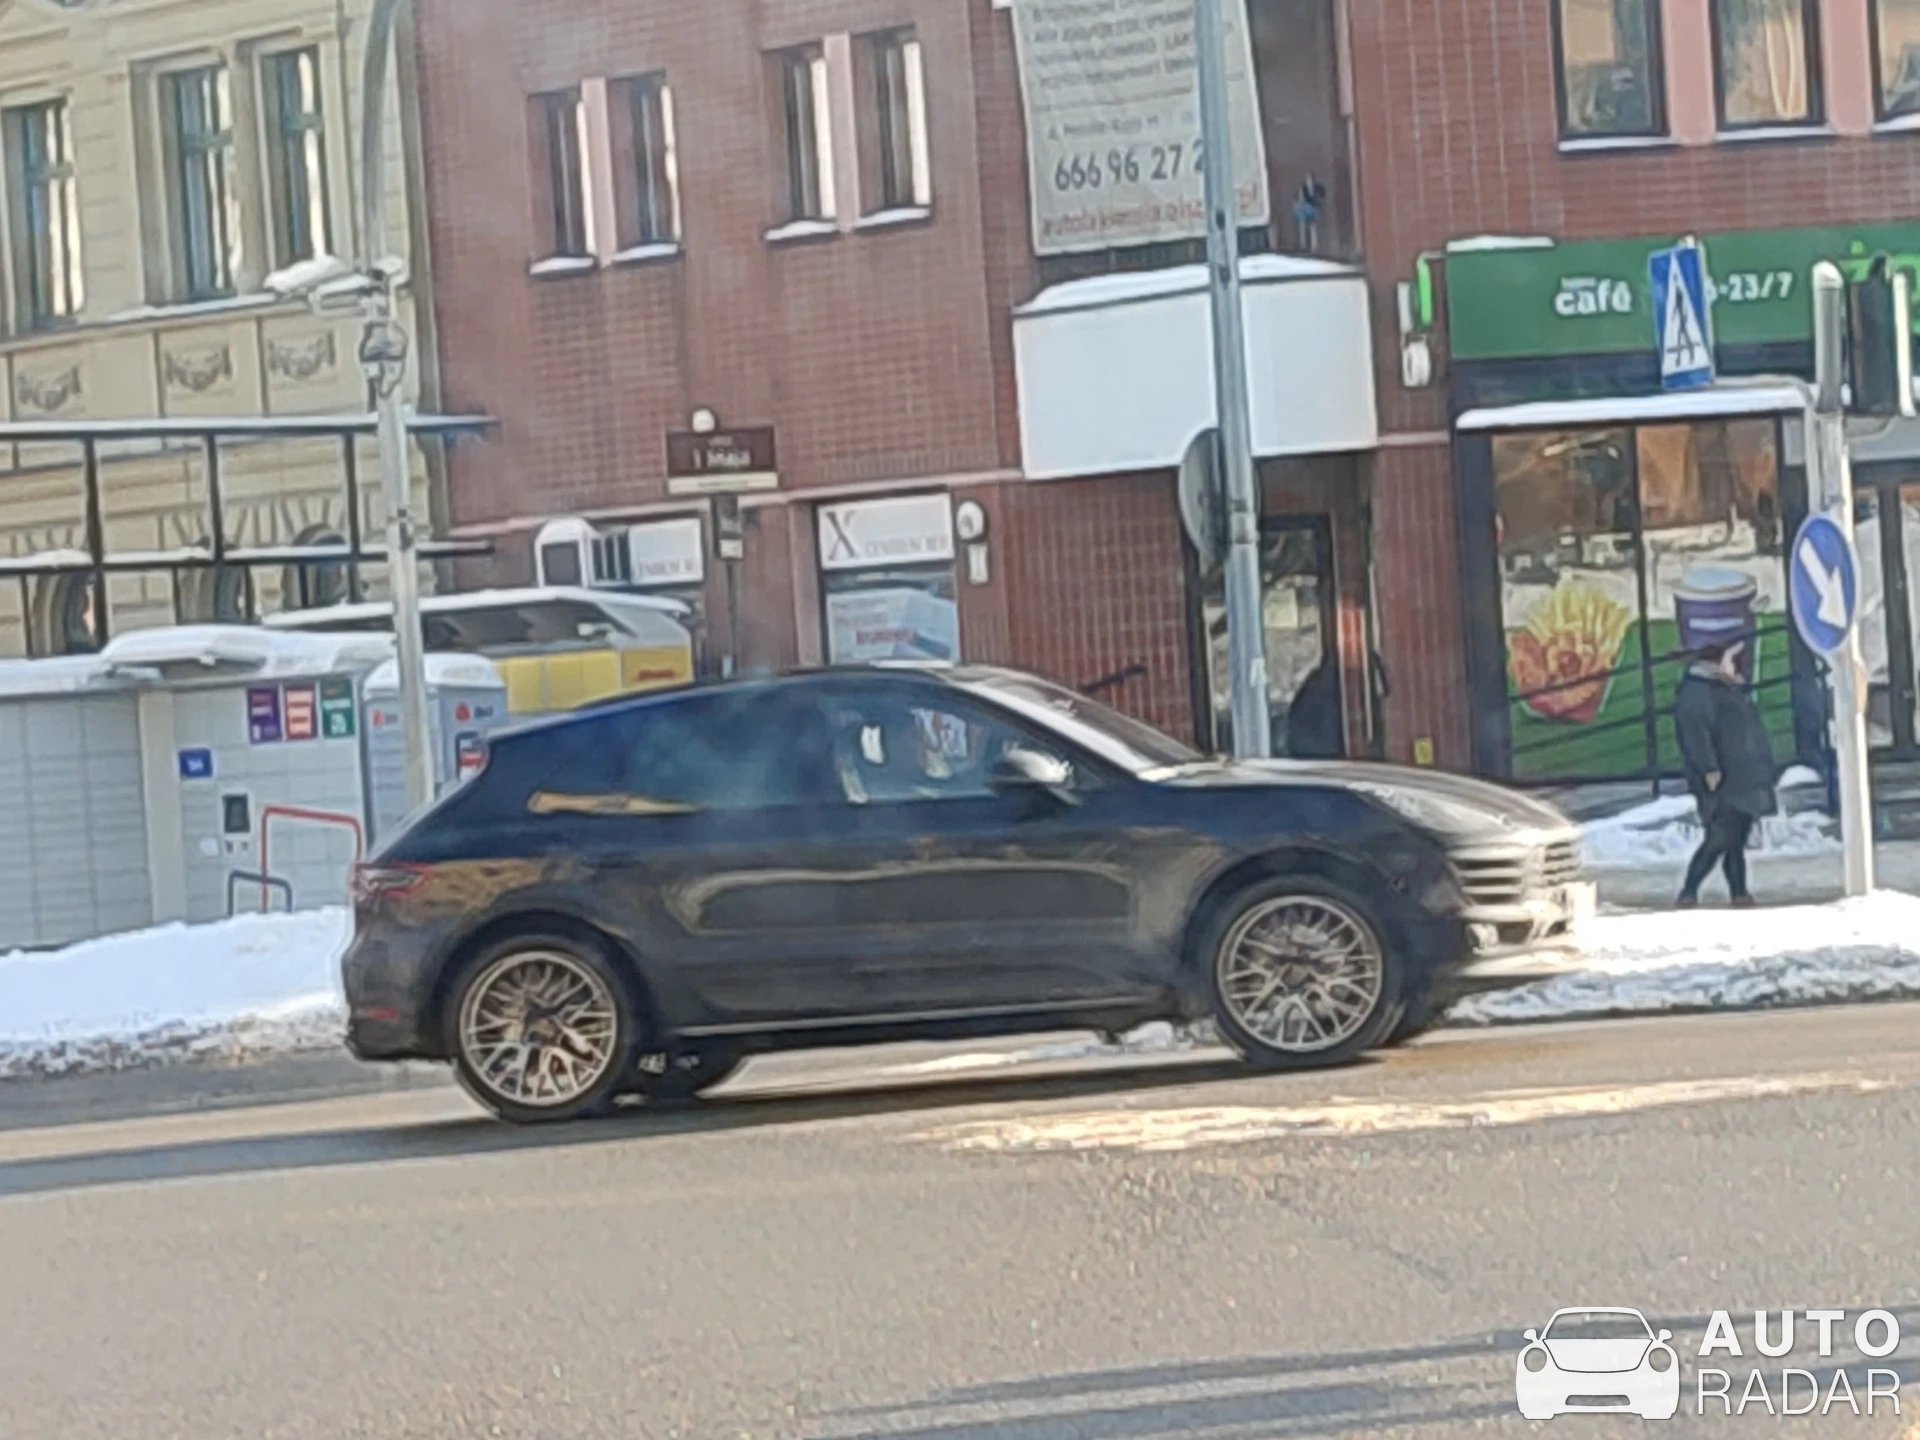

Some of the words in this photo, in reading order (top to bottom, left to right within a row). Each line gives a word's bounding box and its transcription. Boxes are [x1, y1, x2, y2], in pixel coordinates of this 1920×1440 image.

[1055, 154, 1102, 191] 666
[1108, 148, 1139, 184] 96
[1151, 143, 1182, 180] 27
